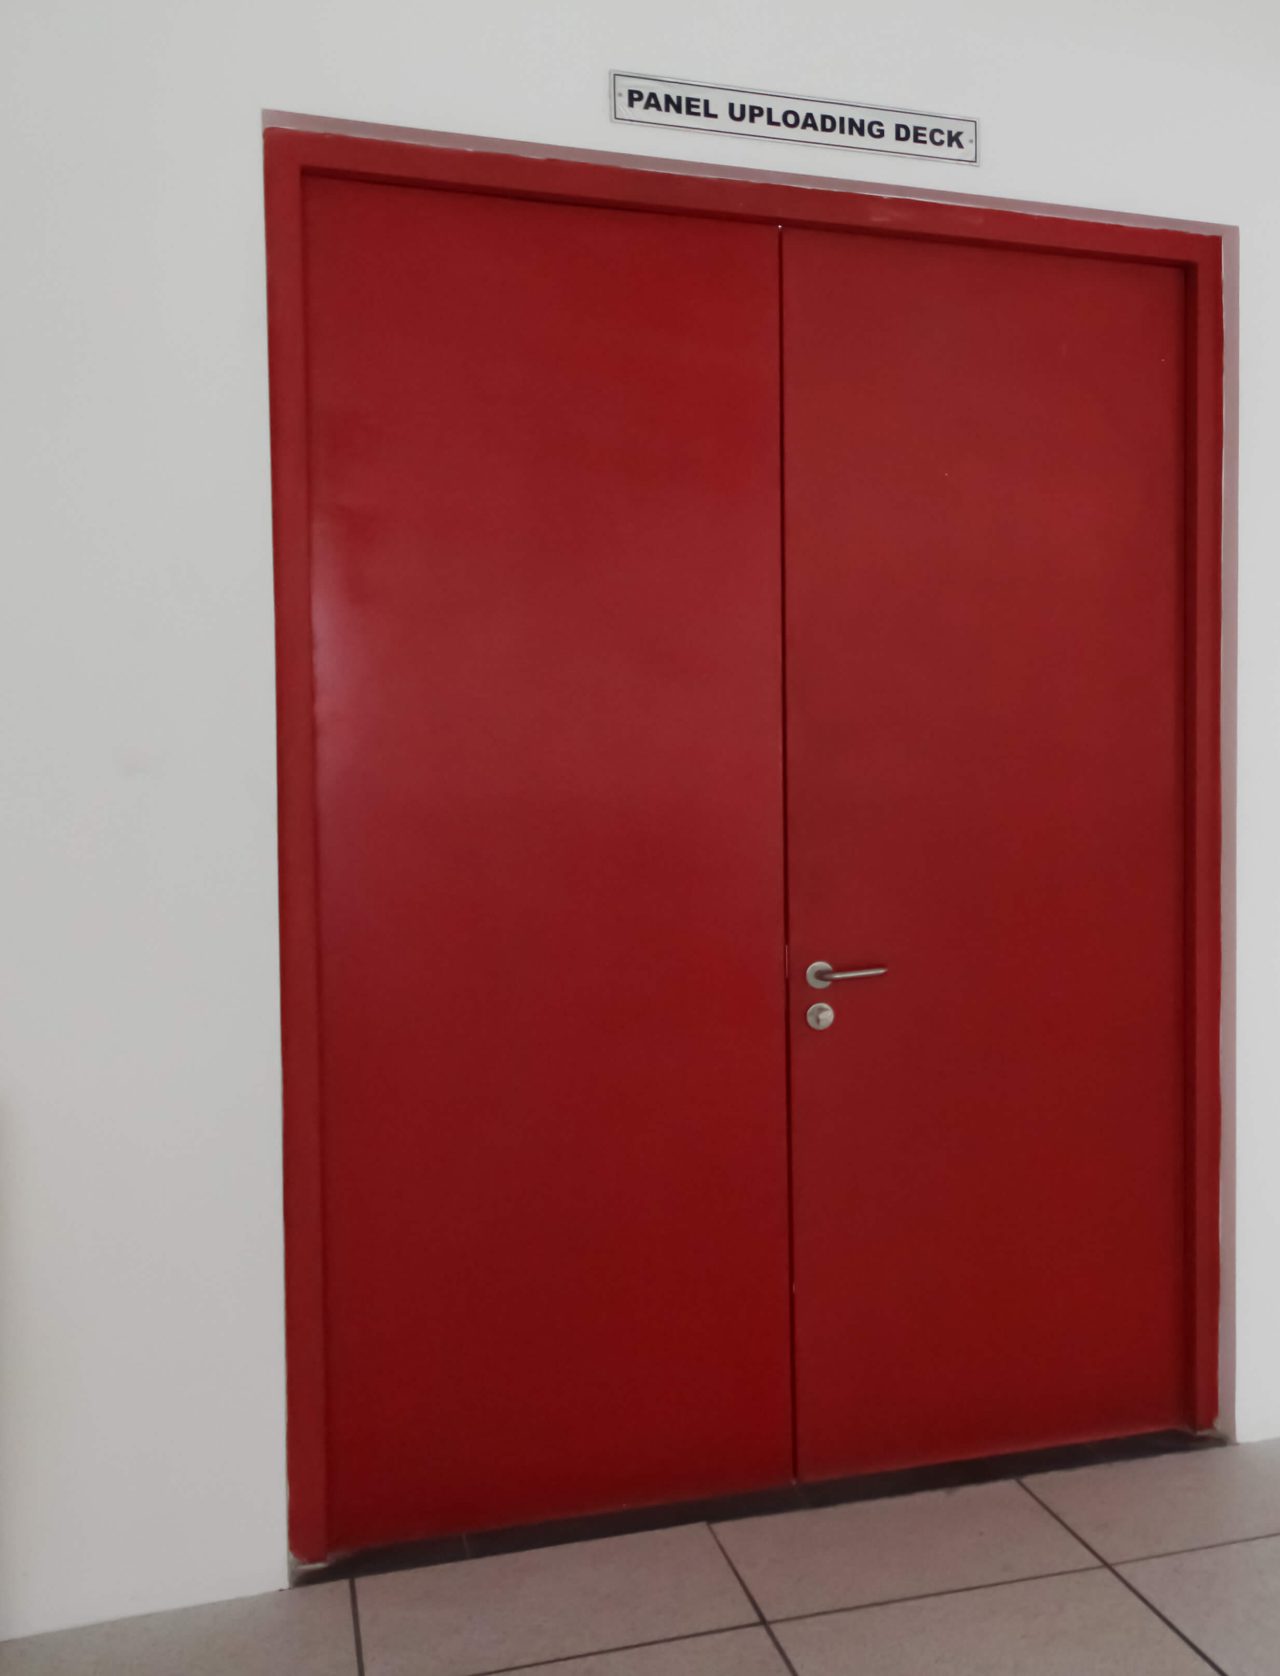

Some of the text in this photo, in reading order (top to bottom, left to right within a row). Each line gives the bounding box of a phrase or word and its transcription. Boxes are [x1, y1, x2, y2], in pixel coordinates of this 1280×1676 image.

[627, 89, 964, 149] PANEL UPLOADING DECK
